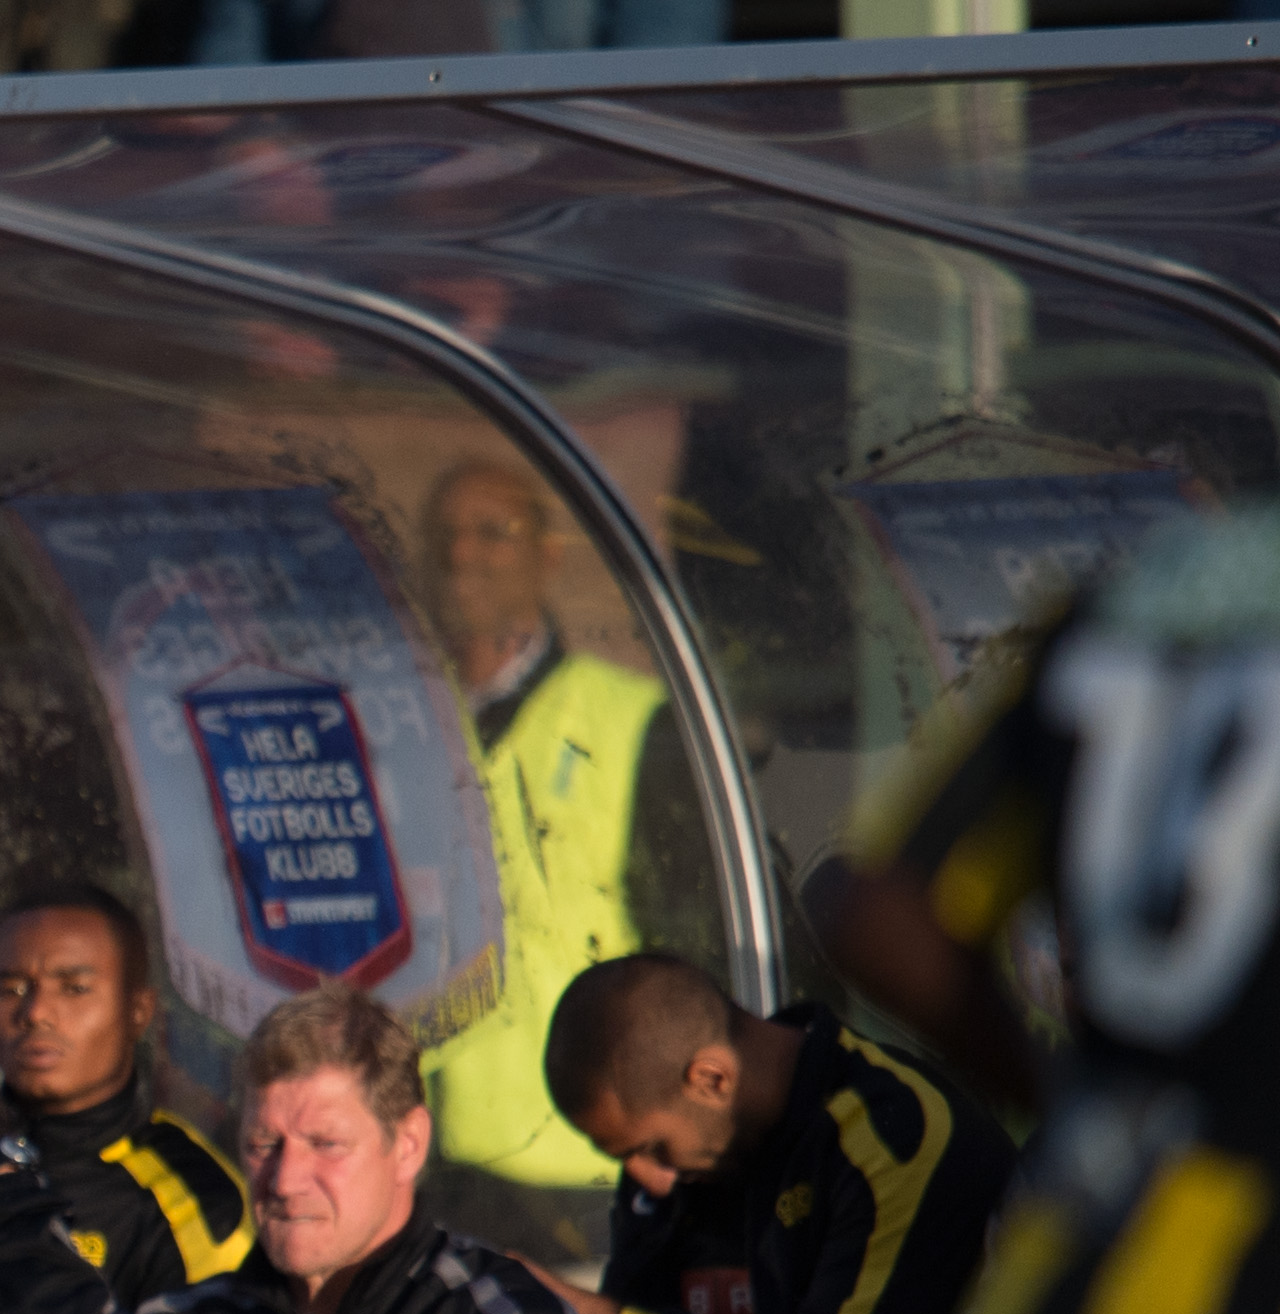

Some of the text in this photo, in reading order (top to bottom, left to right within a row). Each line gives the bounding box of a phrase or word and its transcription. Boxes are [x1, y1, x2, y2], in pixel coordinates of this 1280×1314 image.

[241, 725, 318, 762] HELA
[223, 762, 361, 802] SVERIGES
[230, 801, 373, 843] FOTBOLLS
[265, 841, 358, 881] KLUBB
